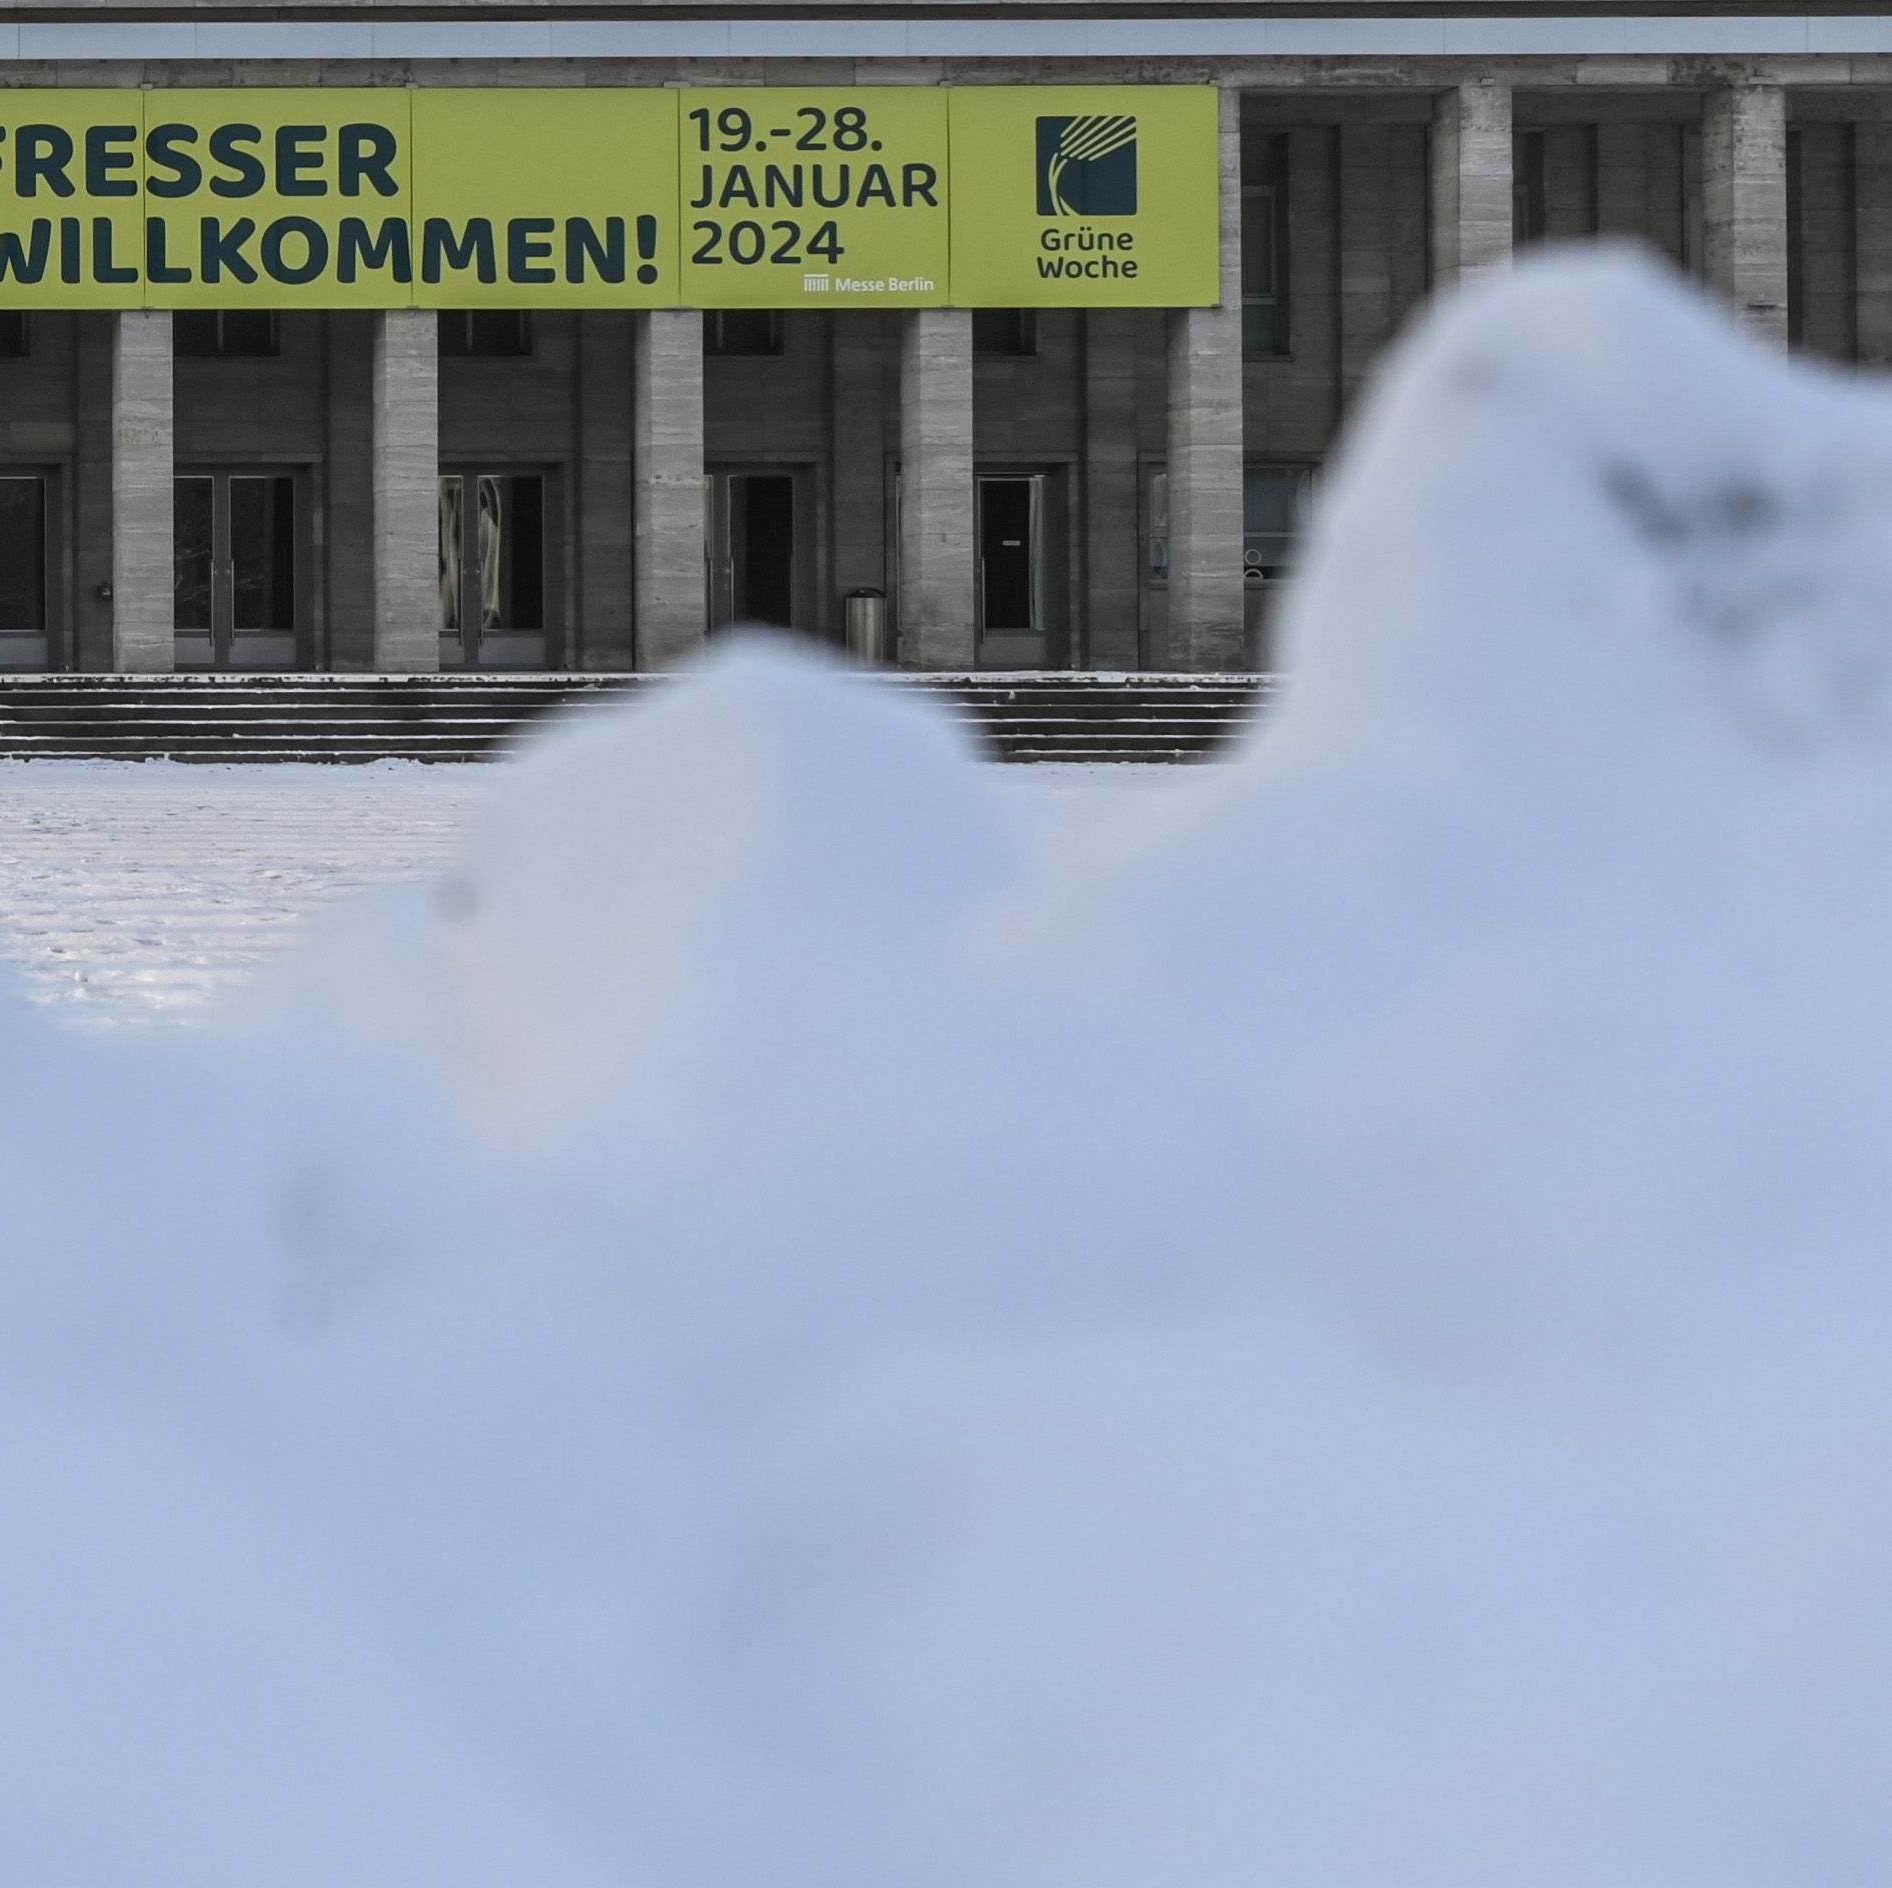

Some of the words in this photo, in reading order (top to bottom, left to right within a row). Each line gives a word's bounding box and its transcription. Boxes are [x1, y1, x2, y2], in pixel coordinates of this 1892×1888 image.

[689, 107, 883, 152] 19.-28.
[690, 163, 938, 208] JANUAR
[691, 220, 845, 265] 2024
[1040, 226, 1134, 251] Grüne
[835, 277, 885, 291] Messe
[888, 277, 934, 291] Berlin
[1036, 255, 1138, 278] Woche
